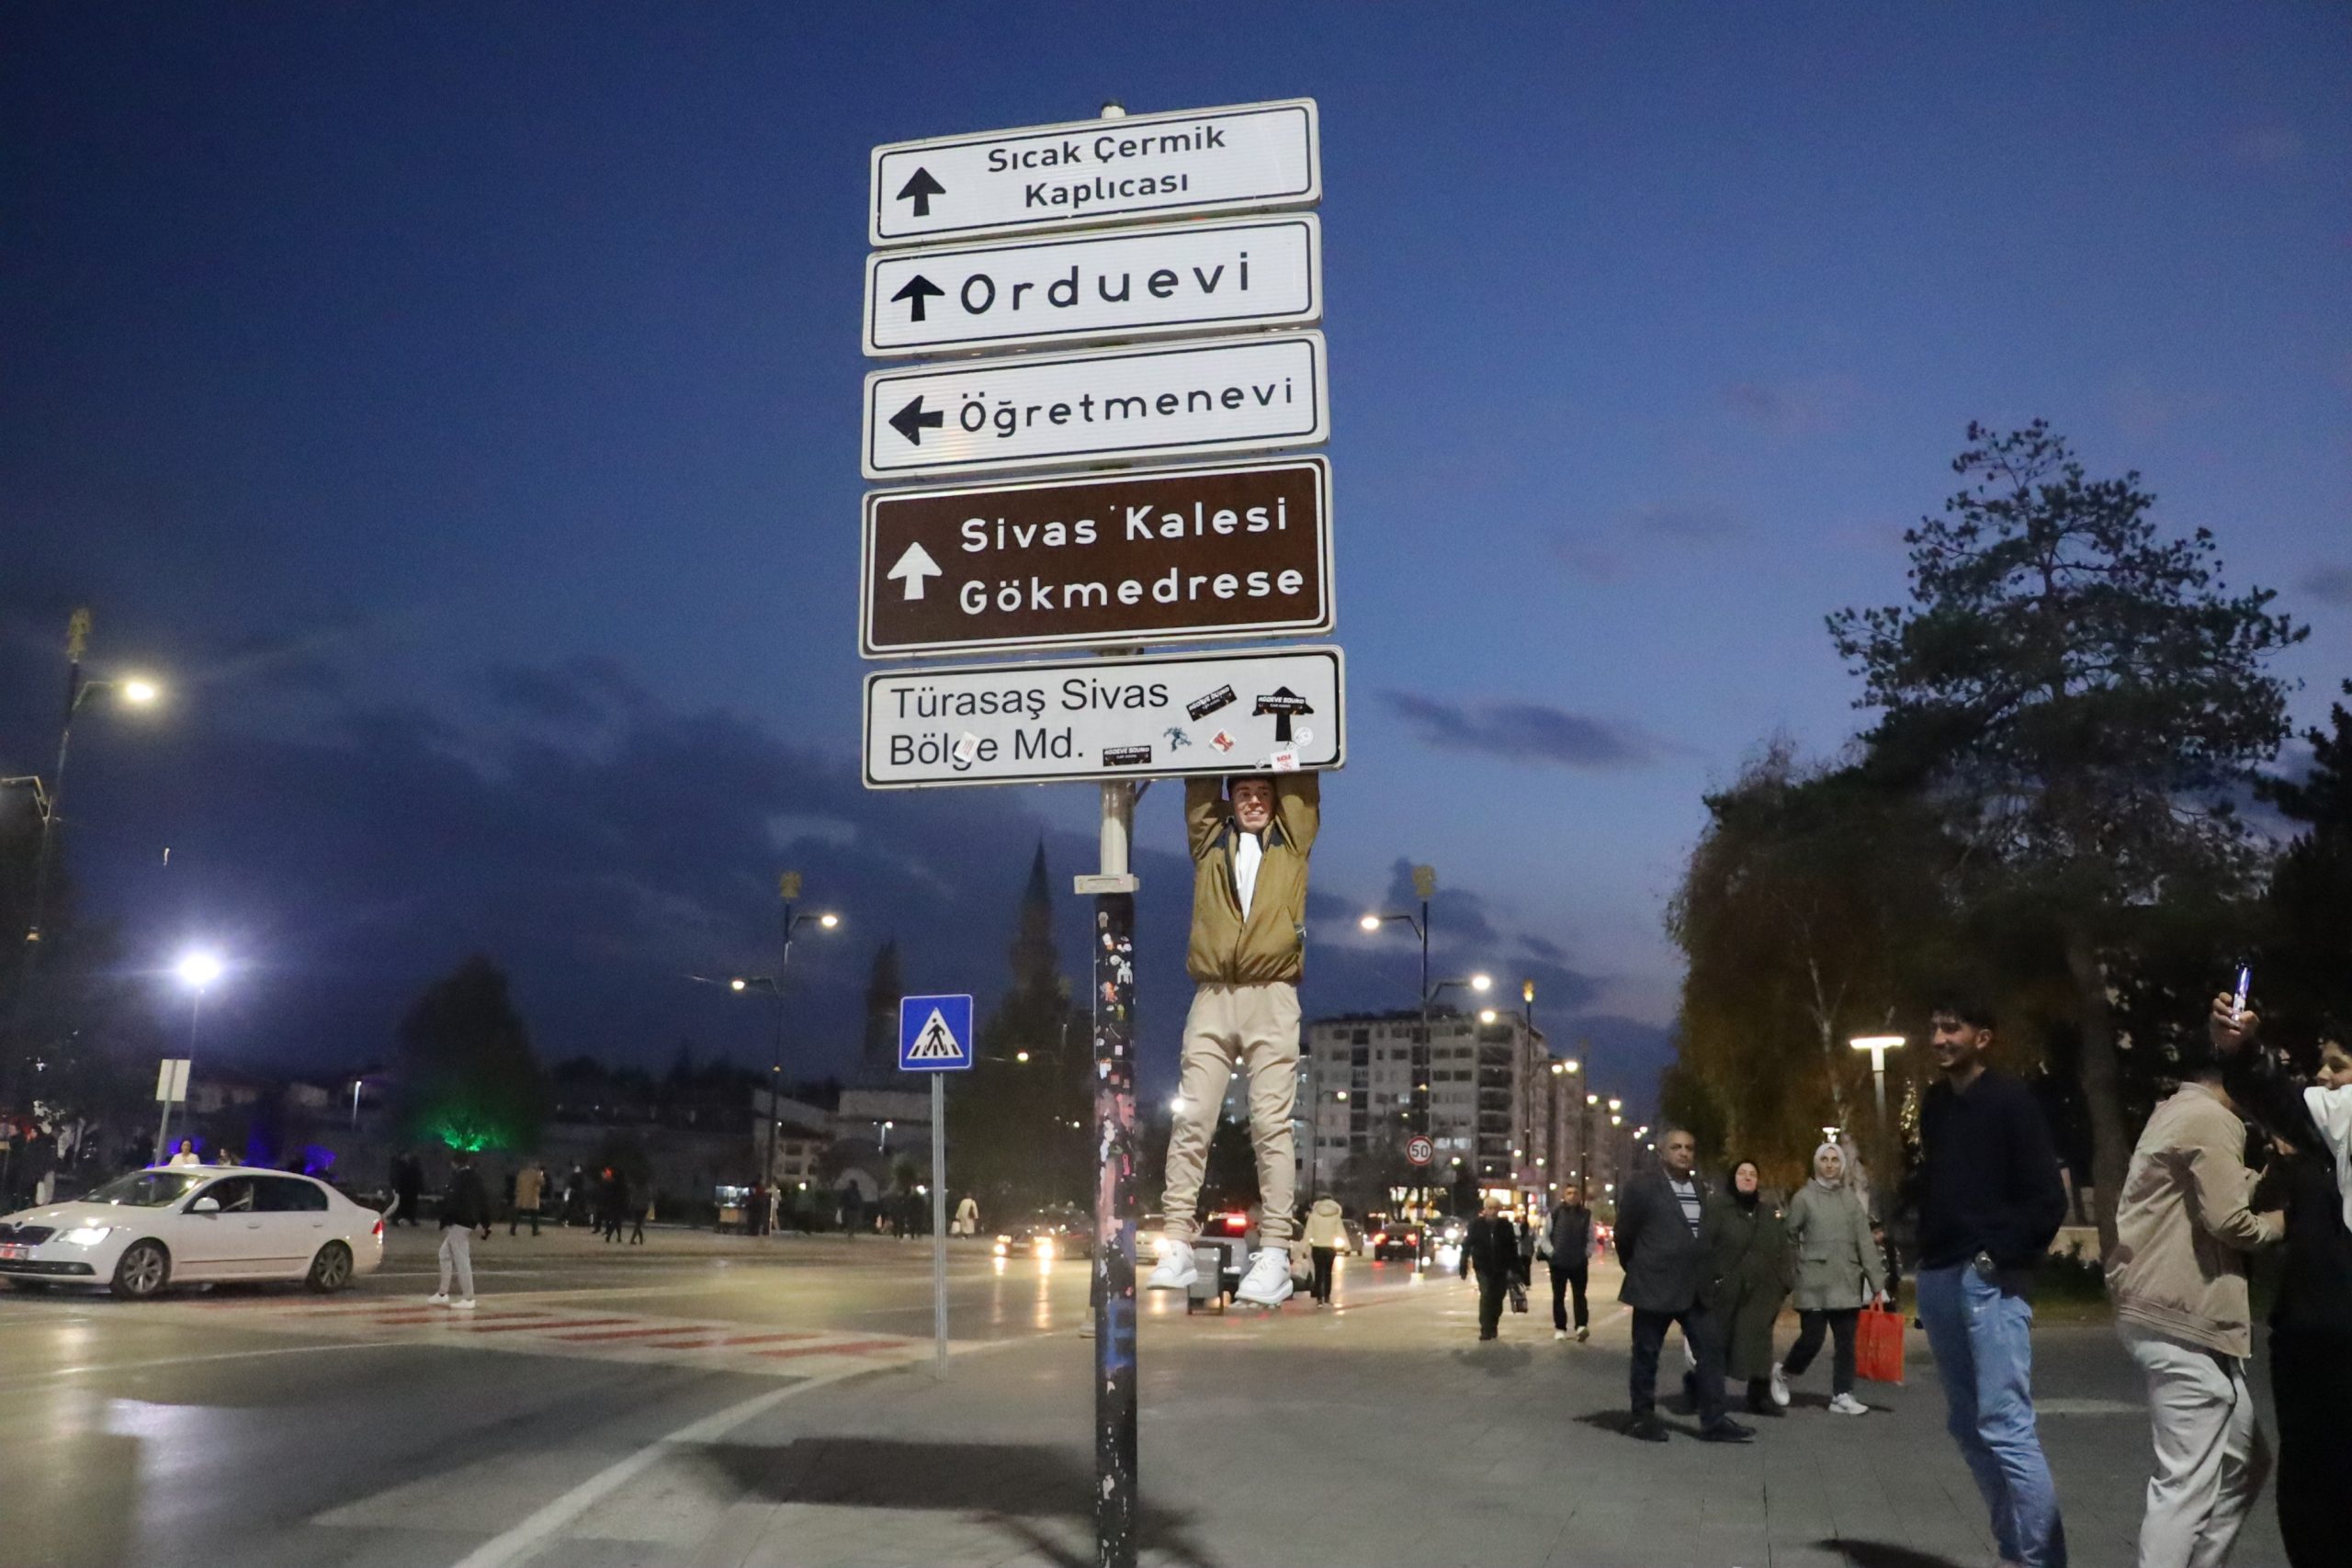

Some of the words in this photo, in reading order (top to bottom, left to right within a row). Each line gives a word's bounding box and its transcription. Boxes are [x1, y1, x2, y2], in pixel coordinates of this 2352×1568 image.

[988, 141, 1082, 174] Sıcak
[1093, 126, 1226, 164] Çermik
[1024, 174, 1189, 209] Kaplıcası
[960, 251, 1249, 316] Orduevi
[959, 378, 1293, 439] Öğretmenevi
[960, 516, 1098, 553] Sivas
[1125, 497, 1287, 541] Kalesi
[959, 567, 1305, 615] Gökmedrese
[890, 686, 1047, 720] Türasaş
[1060, 678, 1170, 711] Sivas
[1013, 726, 1084, 761] Md.
[1411, 1145, 1429, 1158] 50
